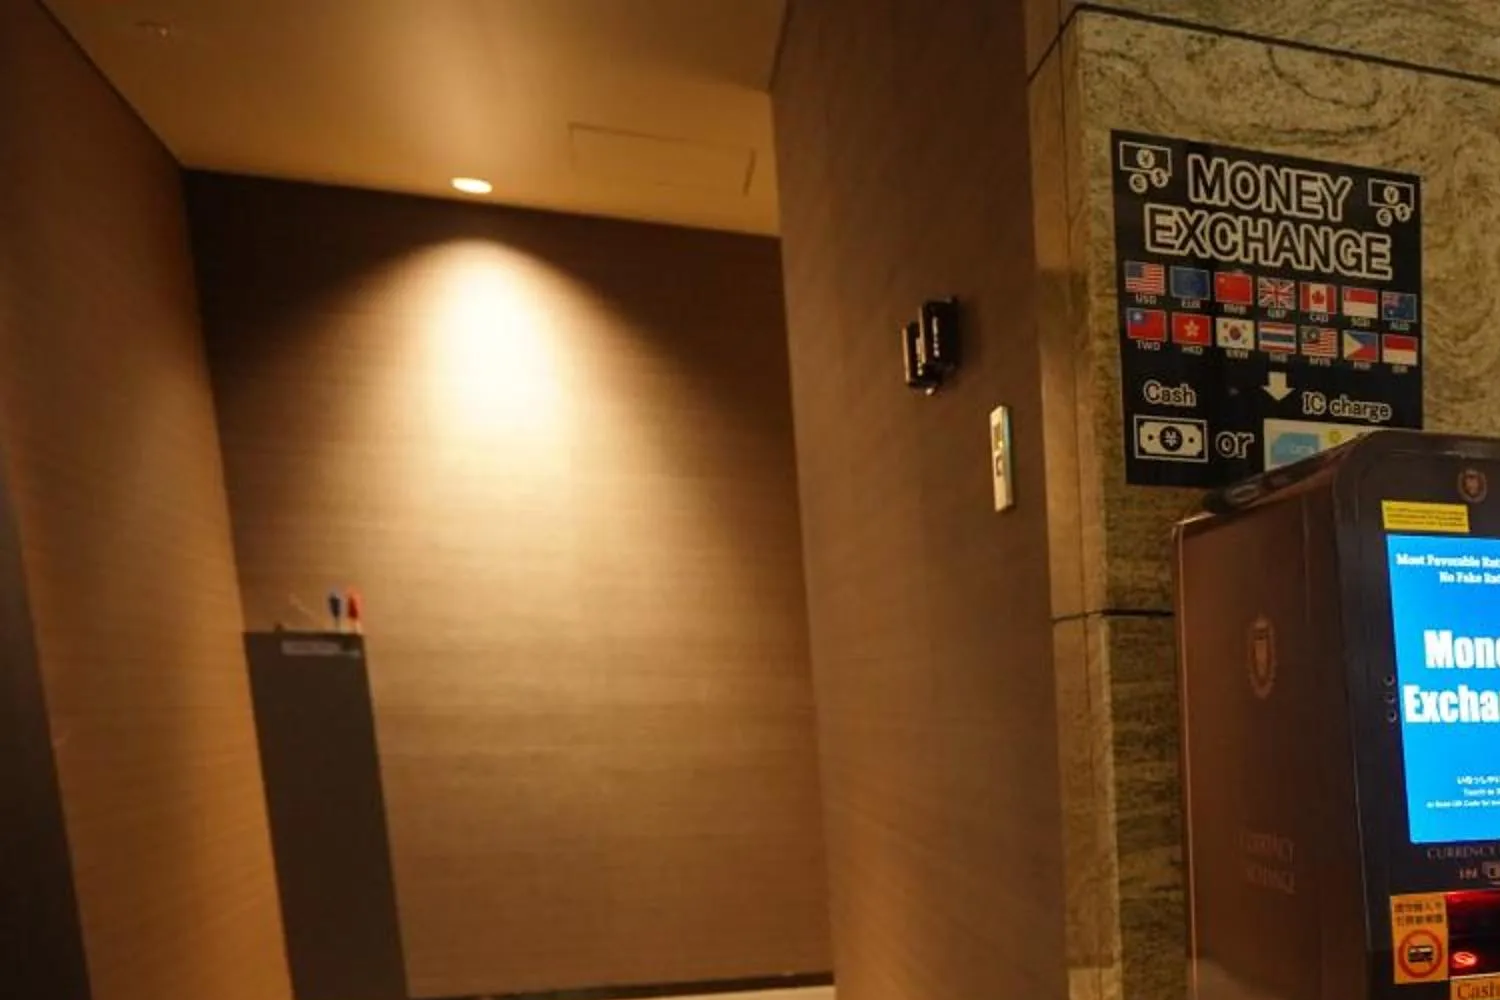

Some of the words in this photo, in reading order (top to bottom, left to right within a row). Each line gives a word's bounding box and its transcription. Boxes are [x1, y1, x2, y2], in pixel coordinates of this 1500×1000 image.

[1187, 154, 1352, 221] MONEY
[1144, 203, 1393, 281] EXCHANGE
[1144, 379, 1197, 407] Cash
[1302, 391, 1326, 415] IC
[1329, 394, 1393, 422] charge
[1215, 431, 1254, 458] or
[1457, 981, 1500, 1000] Cash
